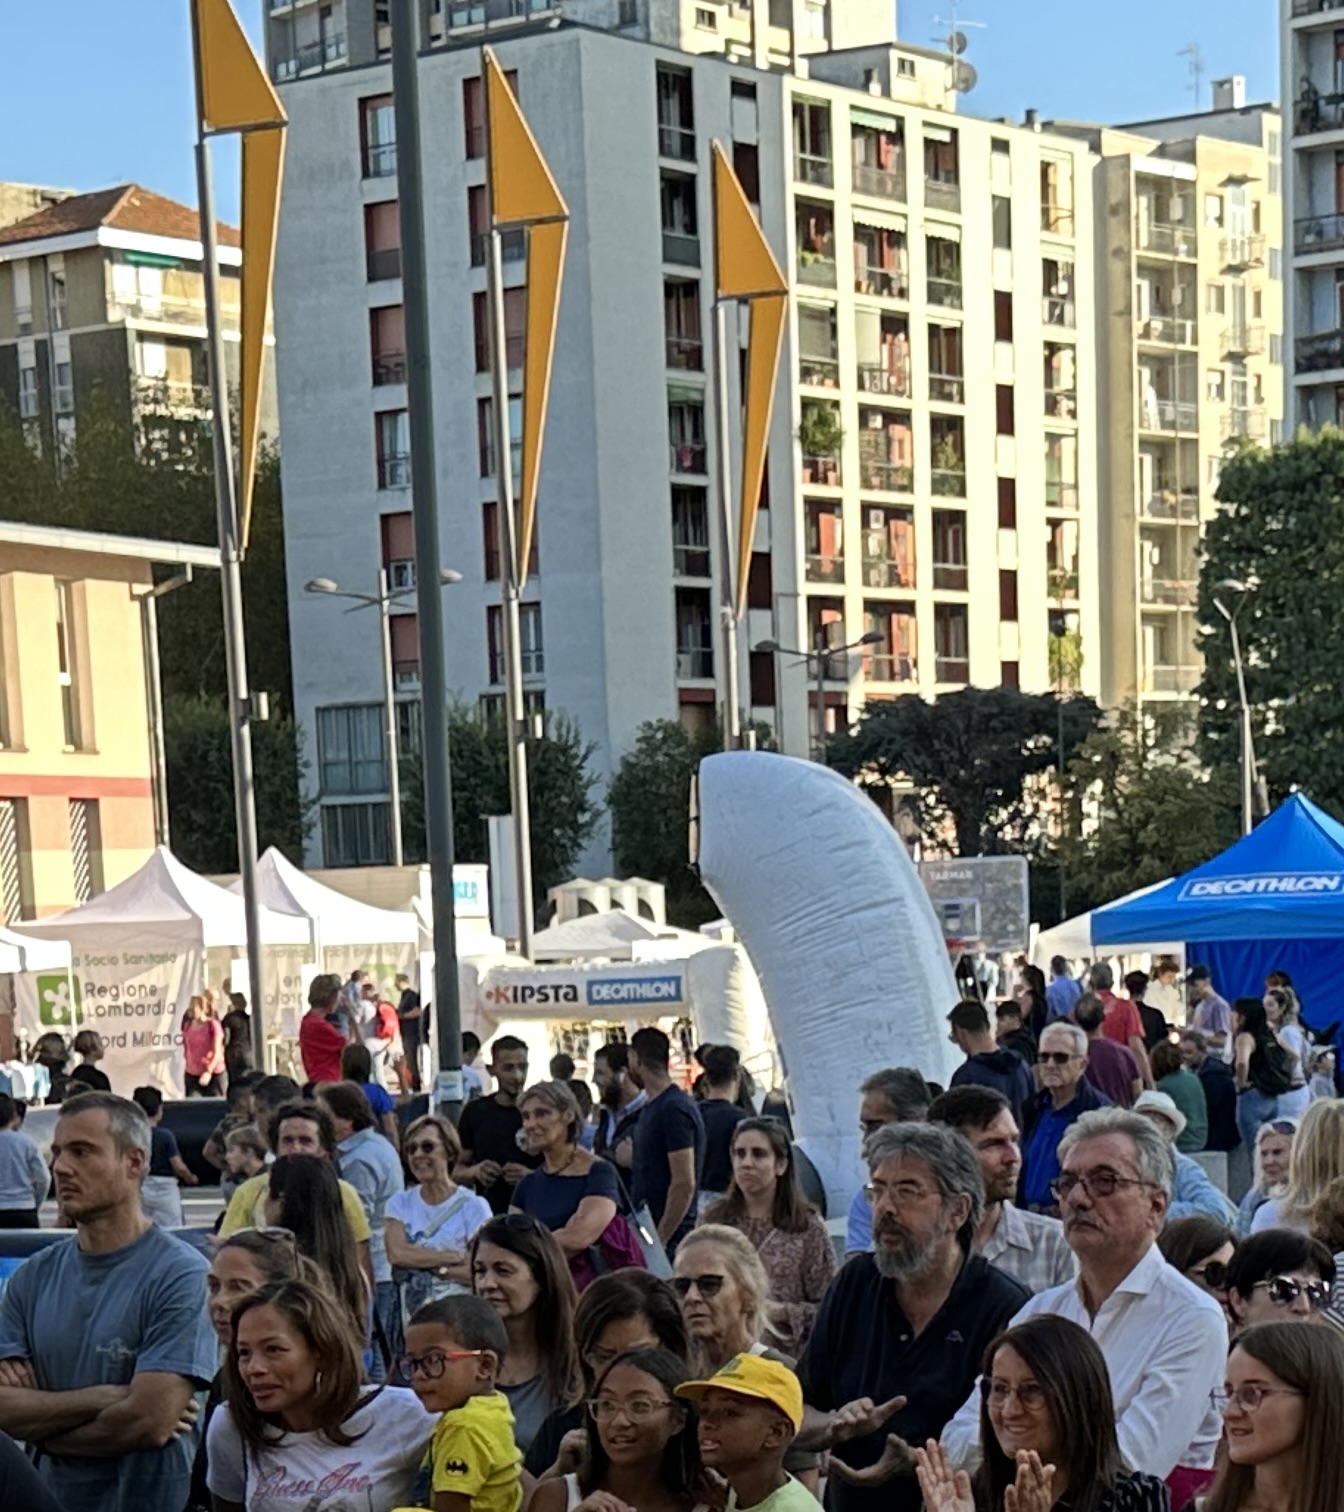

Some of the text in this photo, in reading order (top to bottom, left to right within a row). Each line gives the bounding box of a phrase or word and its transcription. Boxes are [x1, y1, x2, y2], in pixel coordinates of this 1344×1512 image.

[1190, 875, 1341, 896] DECATHLON
[84, 981, 158, 1002] Regione
[592, 980, 676, 1000] DECATHLON
[86, 1001, 177, 1018] Lombardia
[101, 1032, 184, 1048] ord Milano
